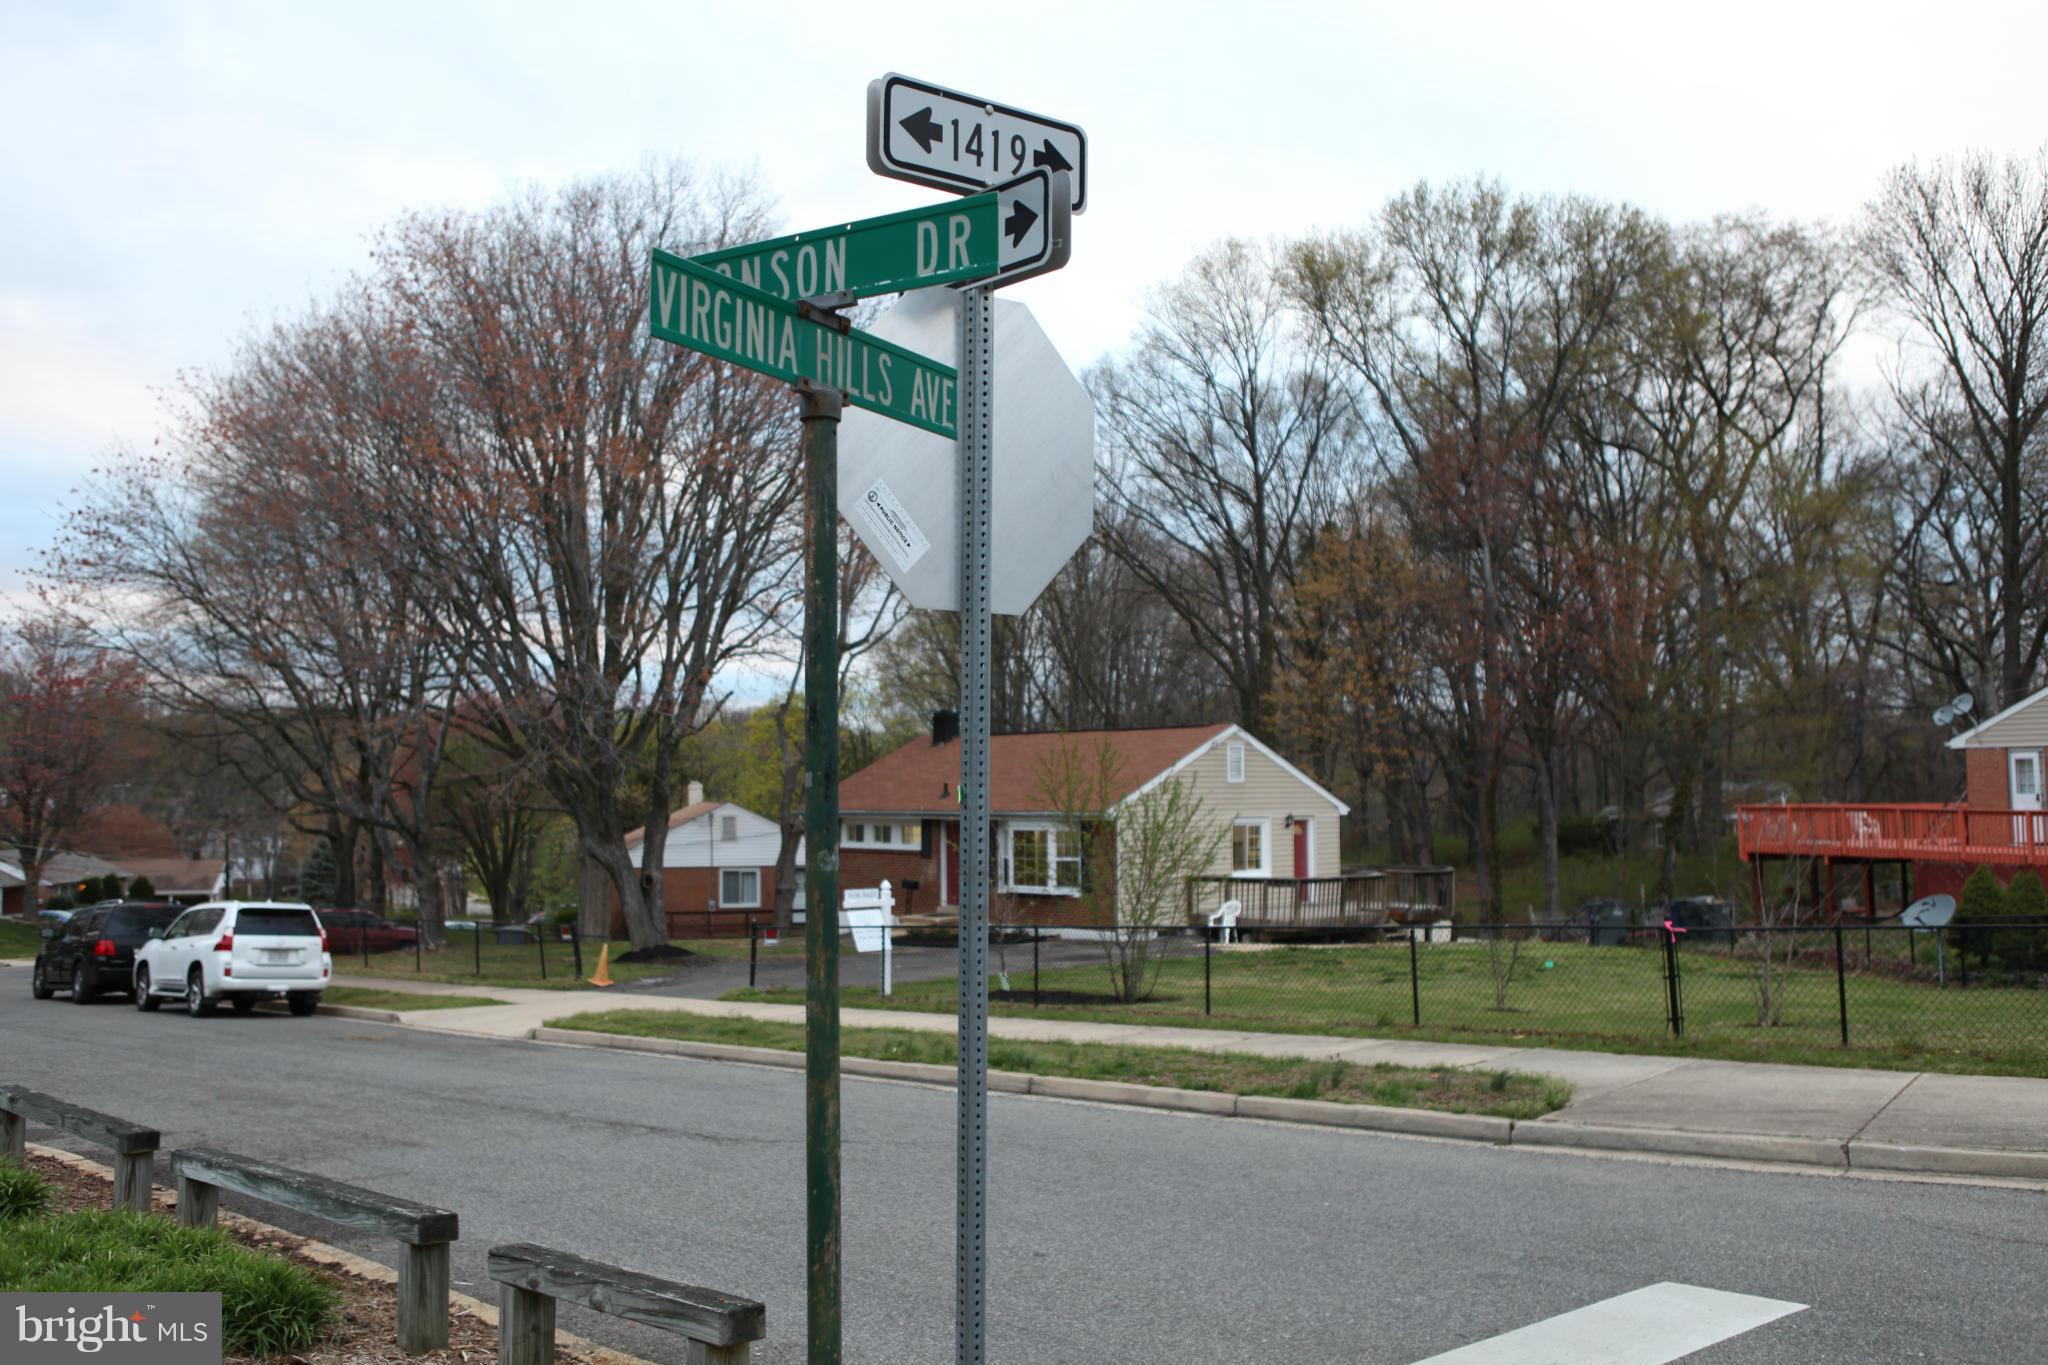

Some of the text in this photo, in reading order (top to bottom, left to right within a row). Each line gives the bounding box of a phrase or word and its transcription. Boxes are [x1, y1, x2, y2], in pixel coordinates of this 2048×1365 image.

[950, 117, 1027, 176] 1419
[916, 213, 972, 278] DR
[656, 264, 955, 430] VIRGINIA HILLS AVE
[879, 505, 895, 526] PUBLIC
[893, 524, 908, 544] NOTICE
